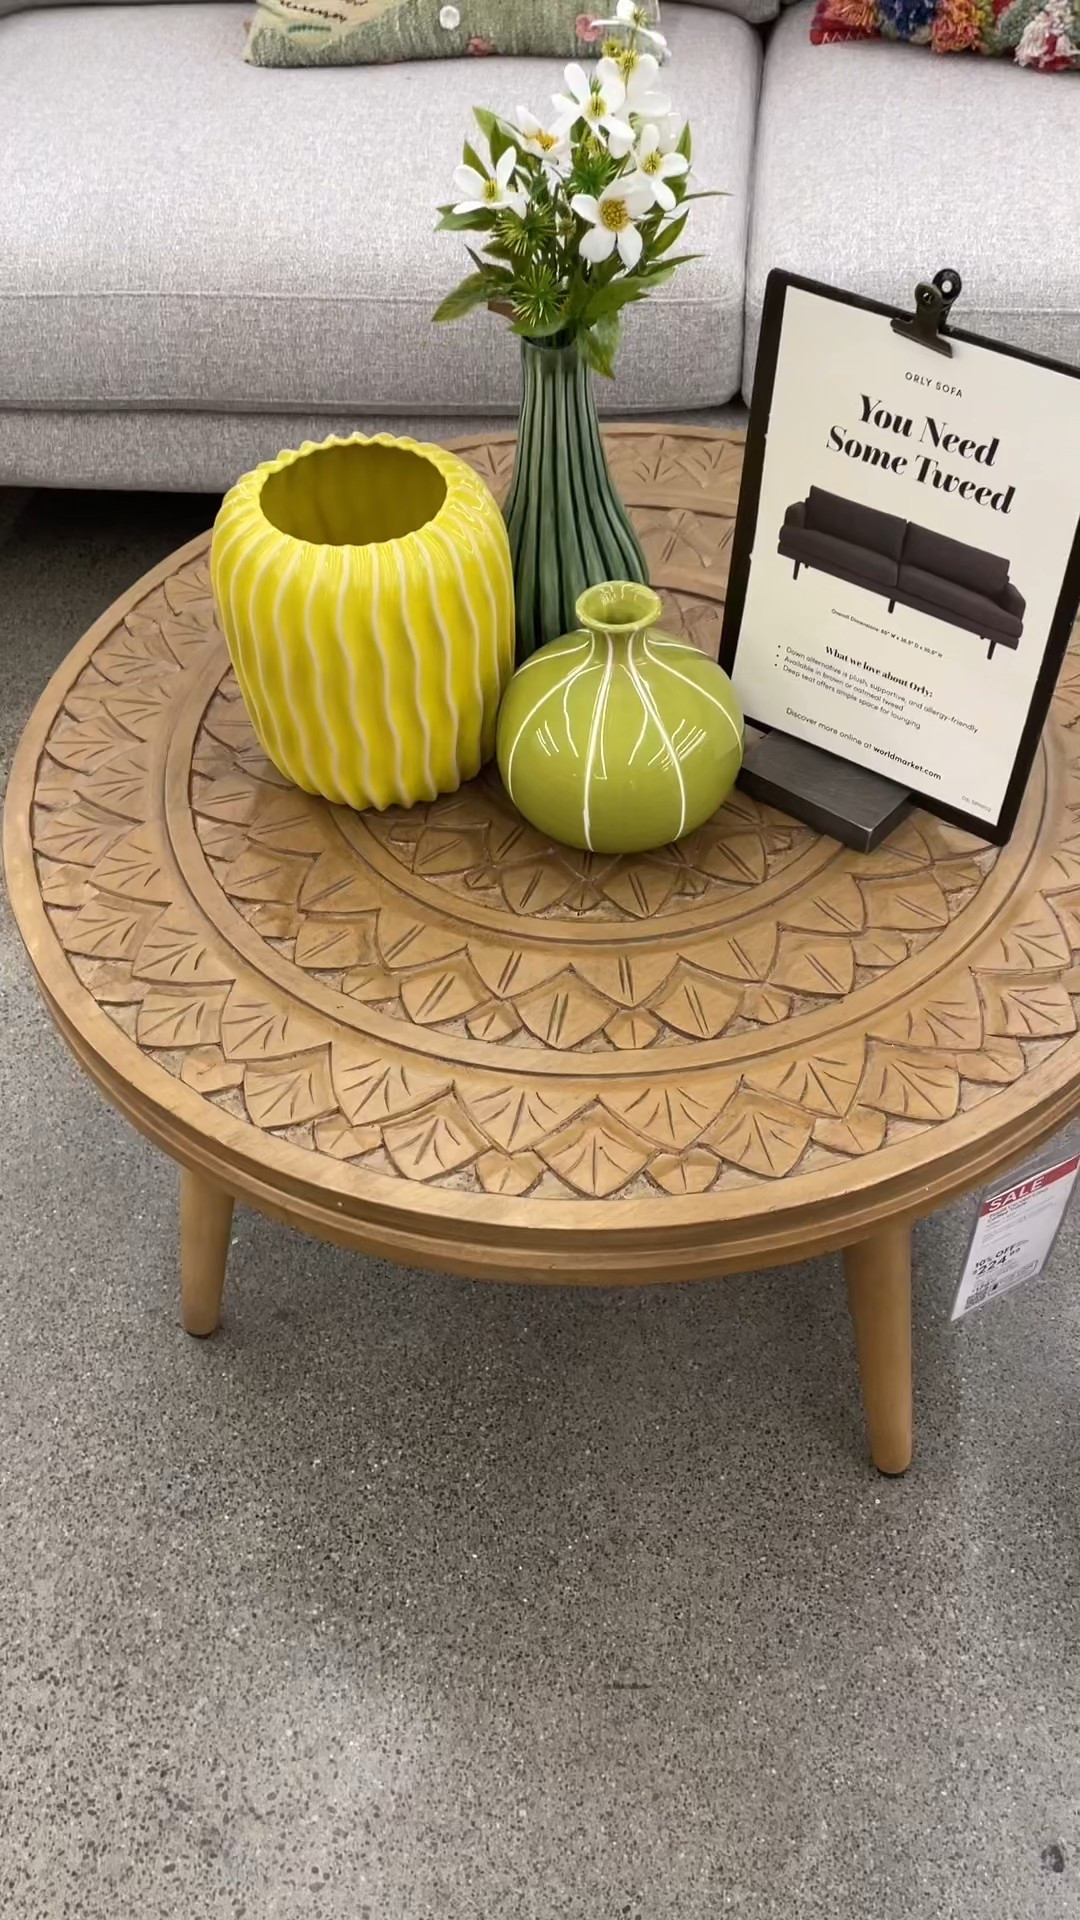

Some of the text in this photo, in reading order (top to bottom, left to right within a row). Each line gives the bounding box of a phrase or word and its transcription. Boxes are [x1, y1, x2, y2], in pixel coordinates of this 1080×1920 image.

[905, 371, 963, 398] ORLY SOFA
[858, 392, 1000, 467] You Need
[825, 425, 1016, 514] Some Tweed
[783, 664, 921, 730] Deep seat offers ample space for lounging
[784, 656, 815, 673] Available
[815, 668, 822, 677] in
[822, 671, 843, 685] brown
[853, 684, 882, 701] oatmeal
[882, 697, 904, 712] tweed
[786, 646, 805, 659] Down
[806, 656, 841, 675] alternative
[908, 699, 923, 710] and
[924, 705, 978, 734] allergy-friendly
[825, 645, 933, 698] What we love about Orly:
[786, 707, 942, 781] Discover more online at worldmarket.com
[988, 1176, 1045, 1212] SALE
